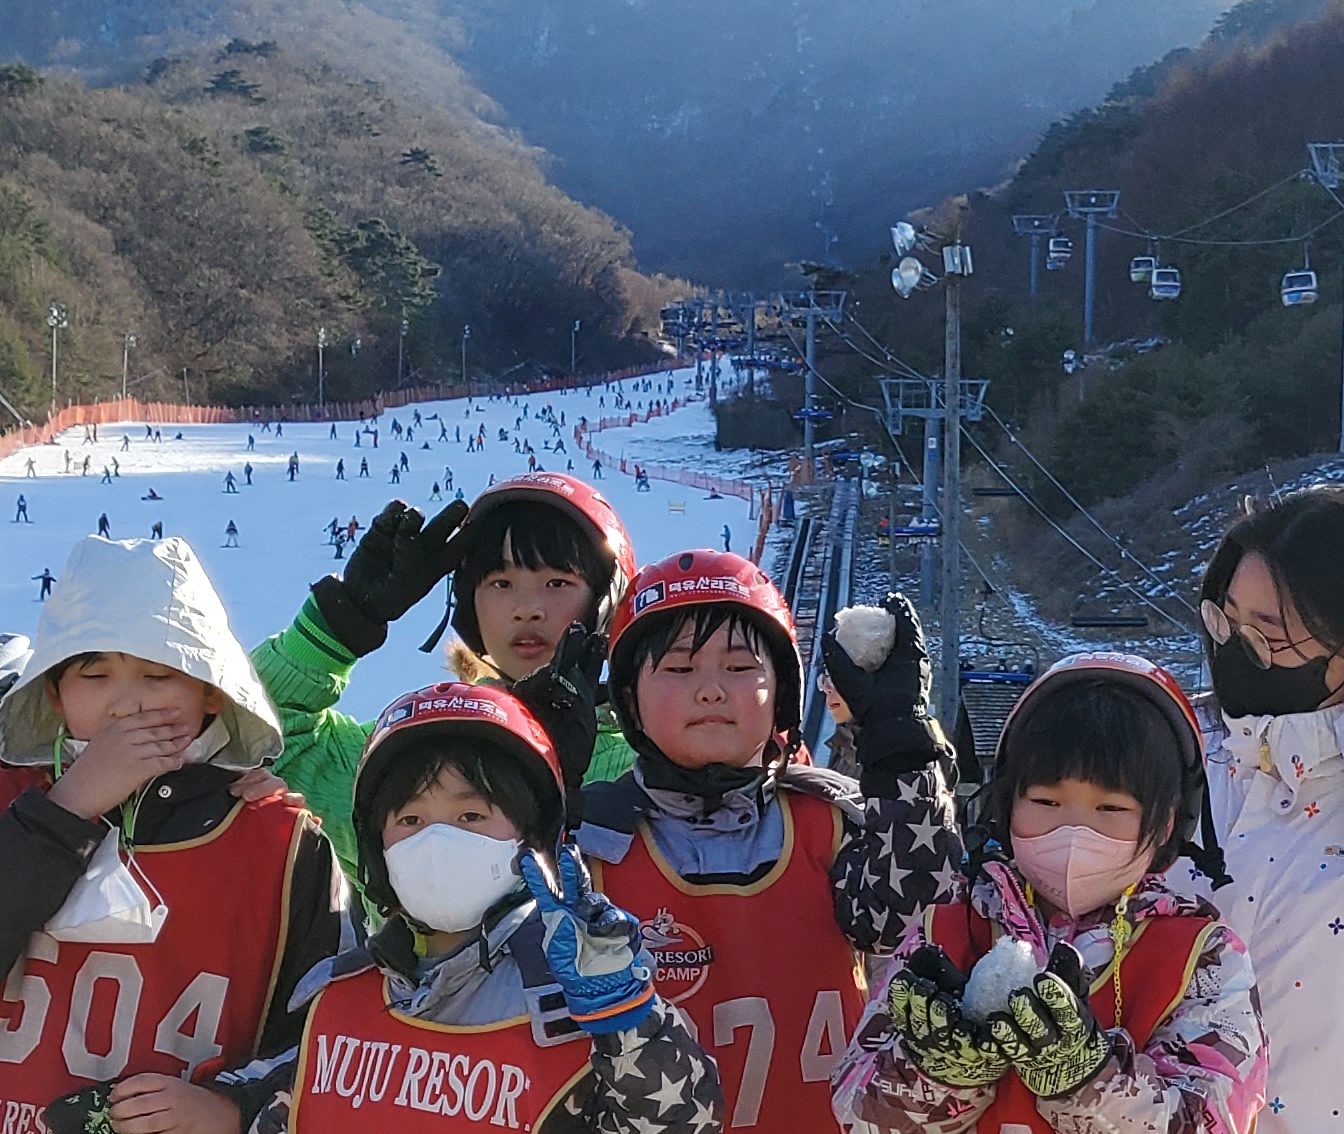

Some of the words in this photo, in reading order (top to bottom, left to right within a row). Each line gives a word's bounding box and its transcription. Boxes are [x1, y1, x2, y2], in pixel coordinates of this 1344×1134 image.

[654, 946, 712, 964] RESORT
[656, 967, 700, 982] CAMP
[311, 1034, 401, 1109] MUJU
